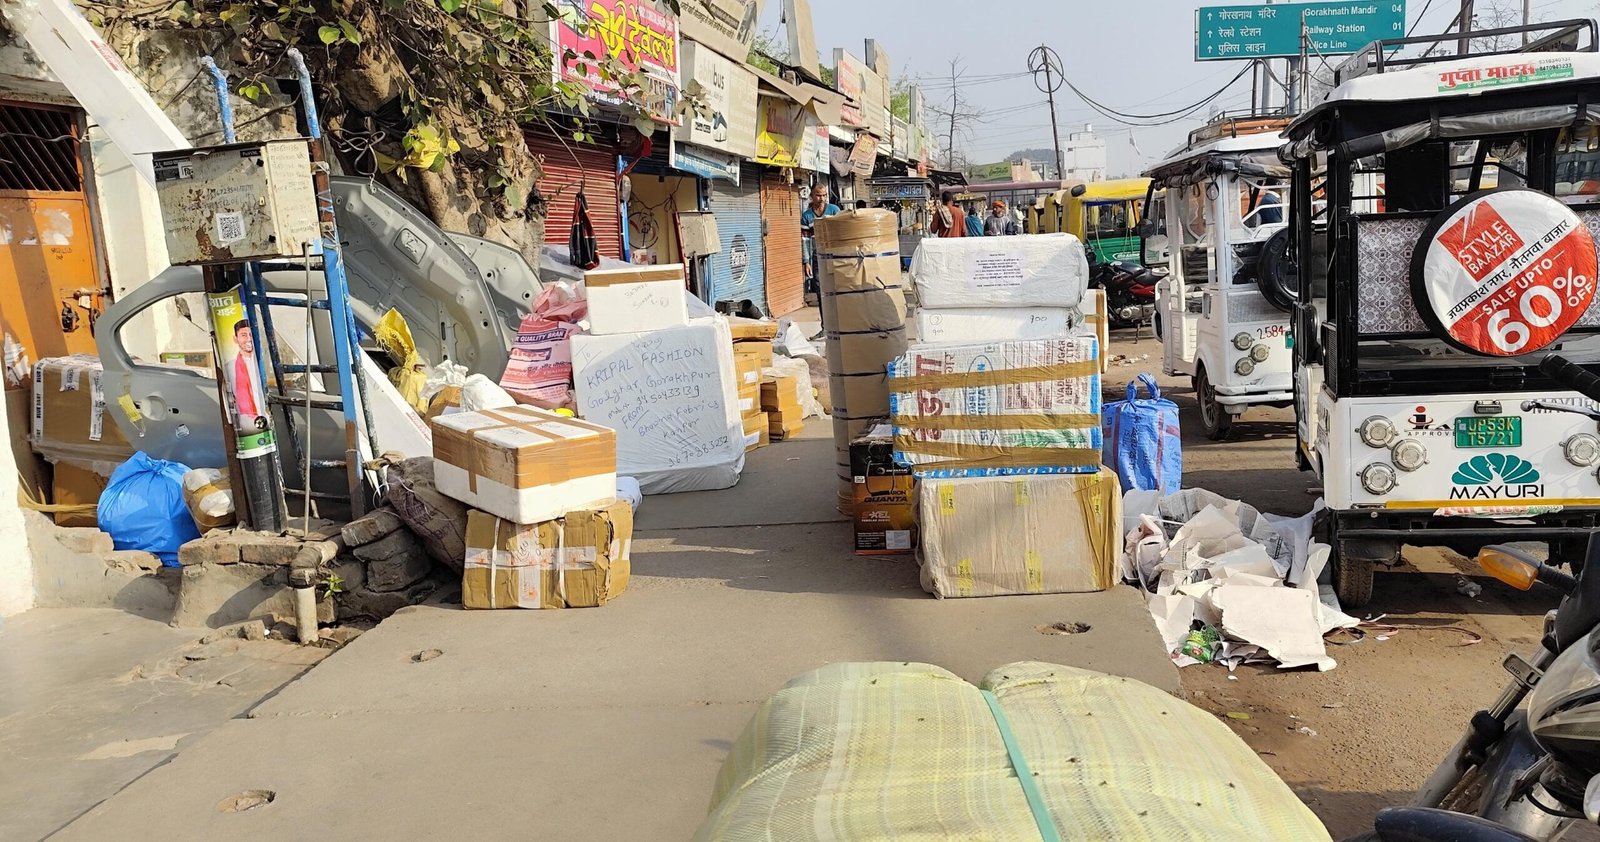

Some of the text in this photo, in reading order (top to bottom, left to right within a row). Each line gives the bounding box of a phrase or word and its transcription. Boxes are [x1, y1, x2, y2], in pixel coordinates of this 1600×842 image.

[1218, 7, 1276, 20] गोरखनाथ मंदिर
[1304, 4, 1402, 17] Gorakhnath Mandir 04
[1218, 25, 1262, 38] रेलवे स्टेशन
[1304, 22, 1402, 36] Railway Station 01
[1218, 41, 1266, 55] पुलिस लाइन
[1330, 40, 1348, 49] Line
[1438, 68, 1482, 89] गुप्ता
[1458, 220, 1508, 265] STYLE
[1467, 233, 1518, 275] BAAZAR
[1447, 283, 1489, 320] जयप्रकाश
[1508, 241, 1544, 272] नौतनवा
[1542, 219, 1572, 246] बाज़ार
[1482, 257, 1553, 317] SALE UPTO
[1487, 266, 1588, 353] 60%
[1029, 314, 1048, 323] 900
[520, 333, 547, 343] QUALITY
[547, 330, 565, 340] BRAN
[1256, 325, 1286, 340] 2584
[586, 347, 703, 390] KRIPAL FASHION
[1468, 418, 1515, 432] UP53K
[1467, 431, 1514, 446] T5721
[1450, 484, 1545, 500] MAYURI
